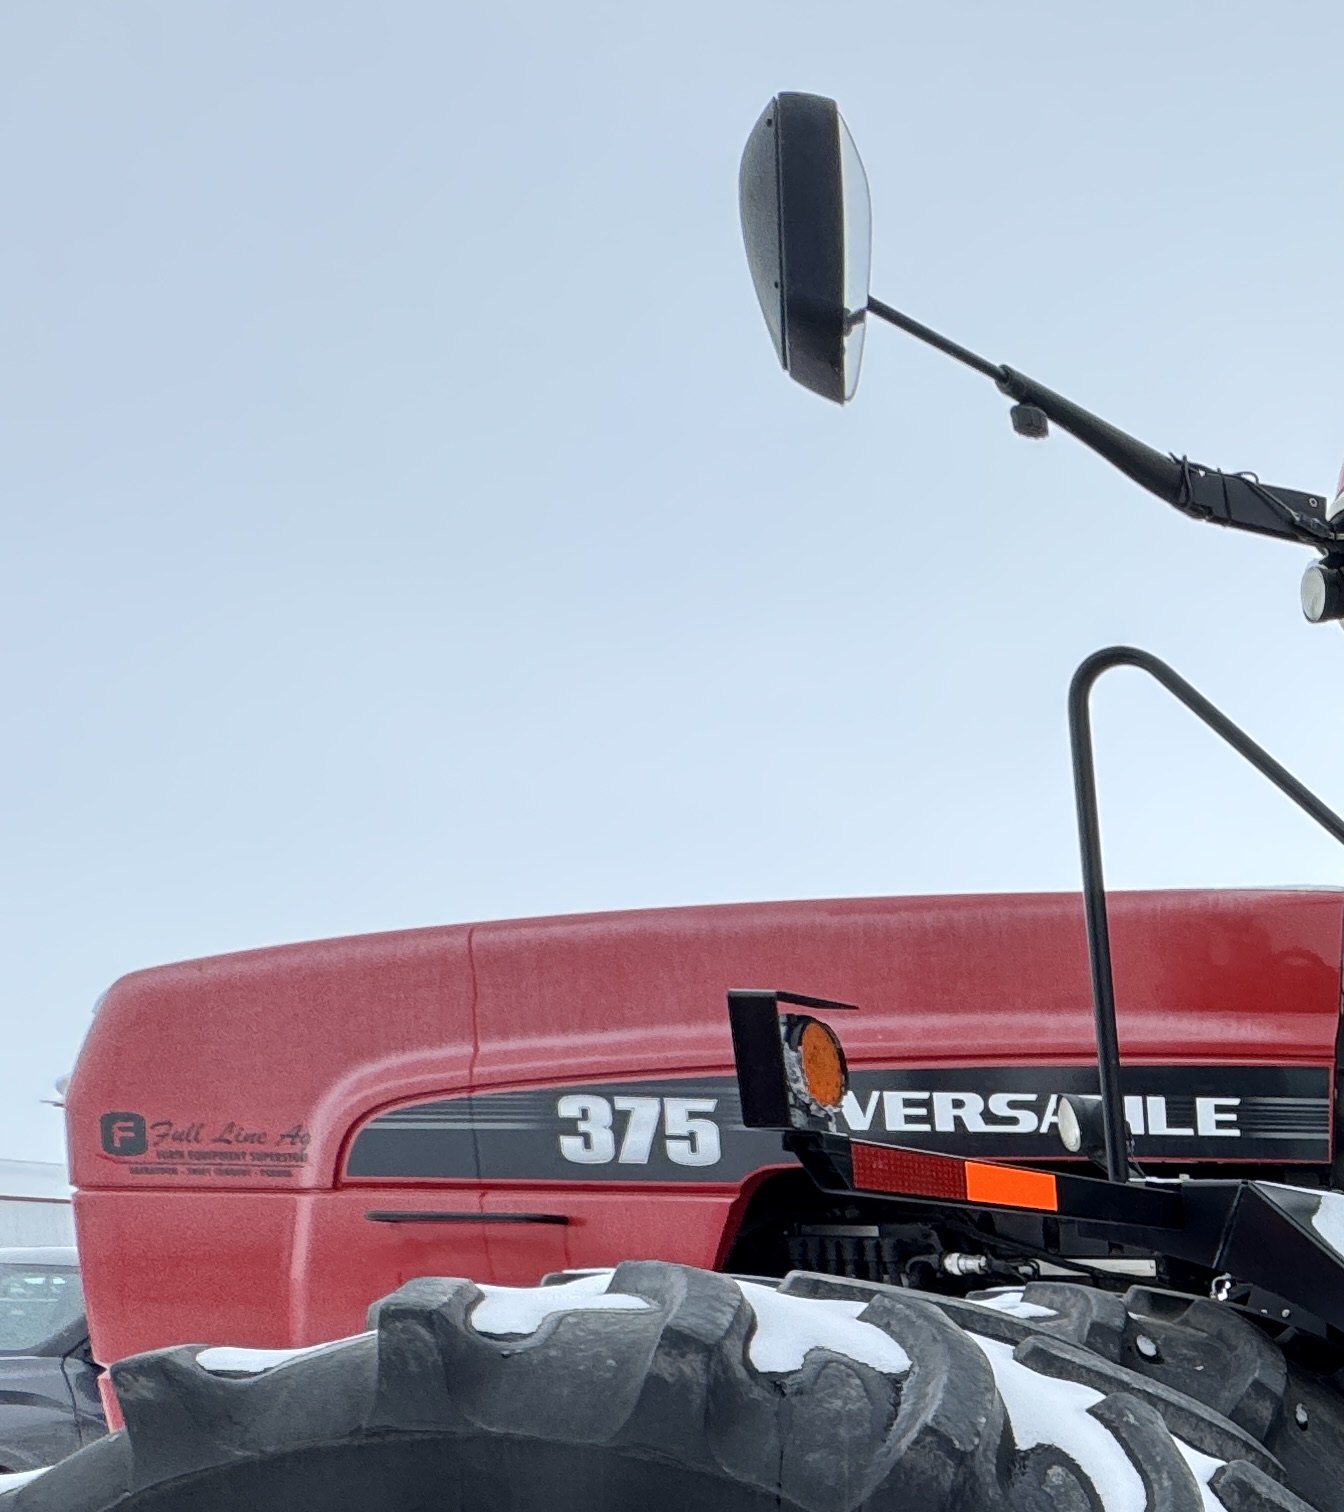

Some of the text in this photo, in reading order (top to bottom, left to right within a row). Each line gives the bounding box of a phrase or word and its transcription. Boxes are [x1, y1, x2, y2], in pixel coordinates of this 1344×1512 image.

[150, 1120, 205, 1147] Full
[211, 1121, 269, 1146] Line
[557, 1094, 722, 1167] 375
[841, 1090, 1242, 1138] VERSILE
